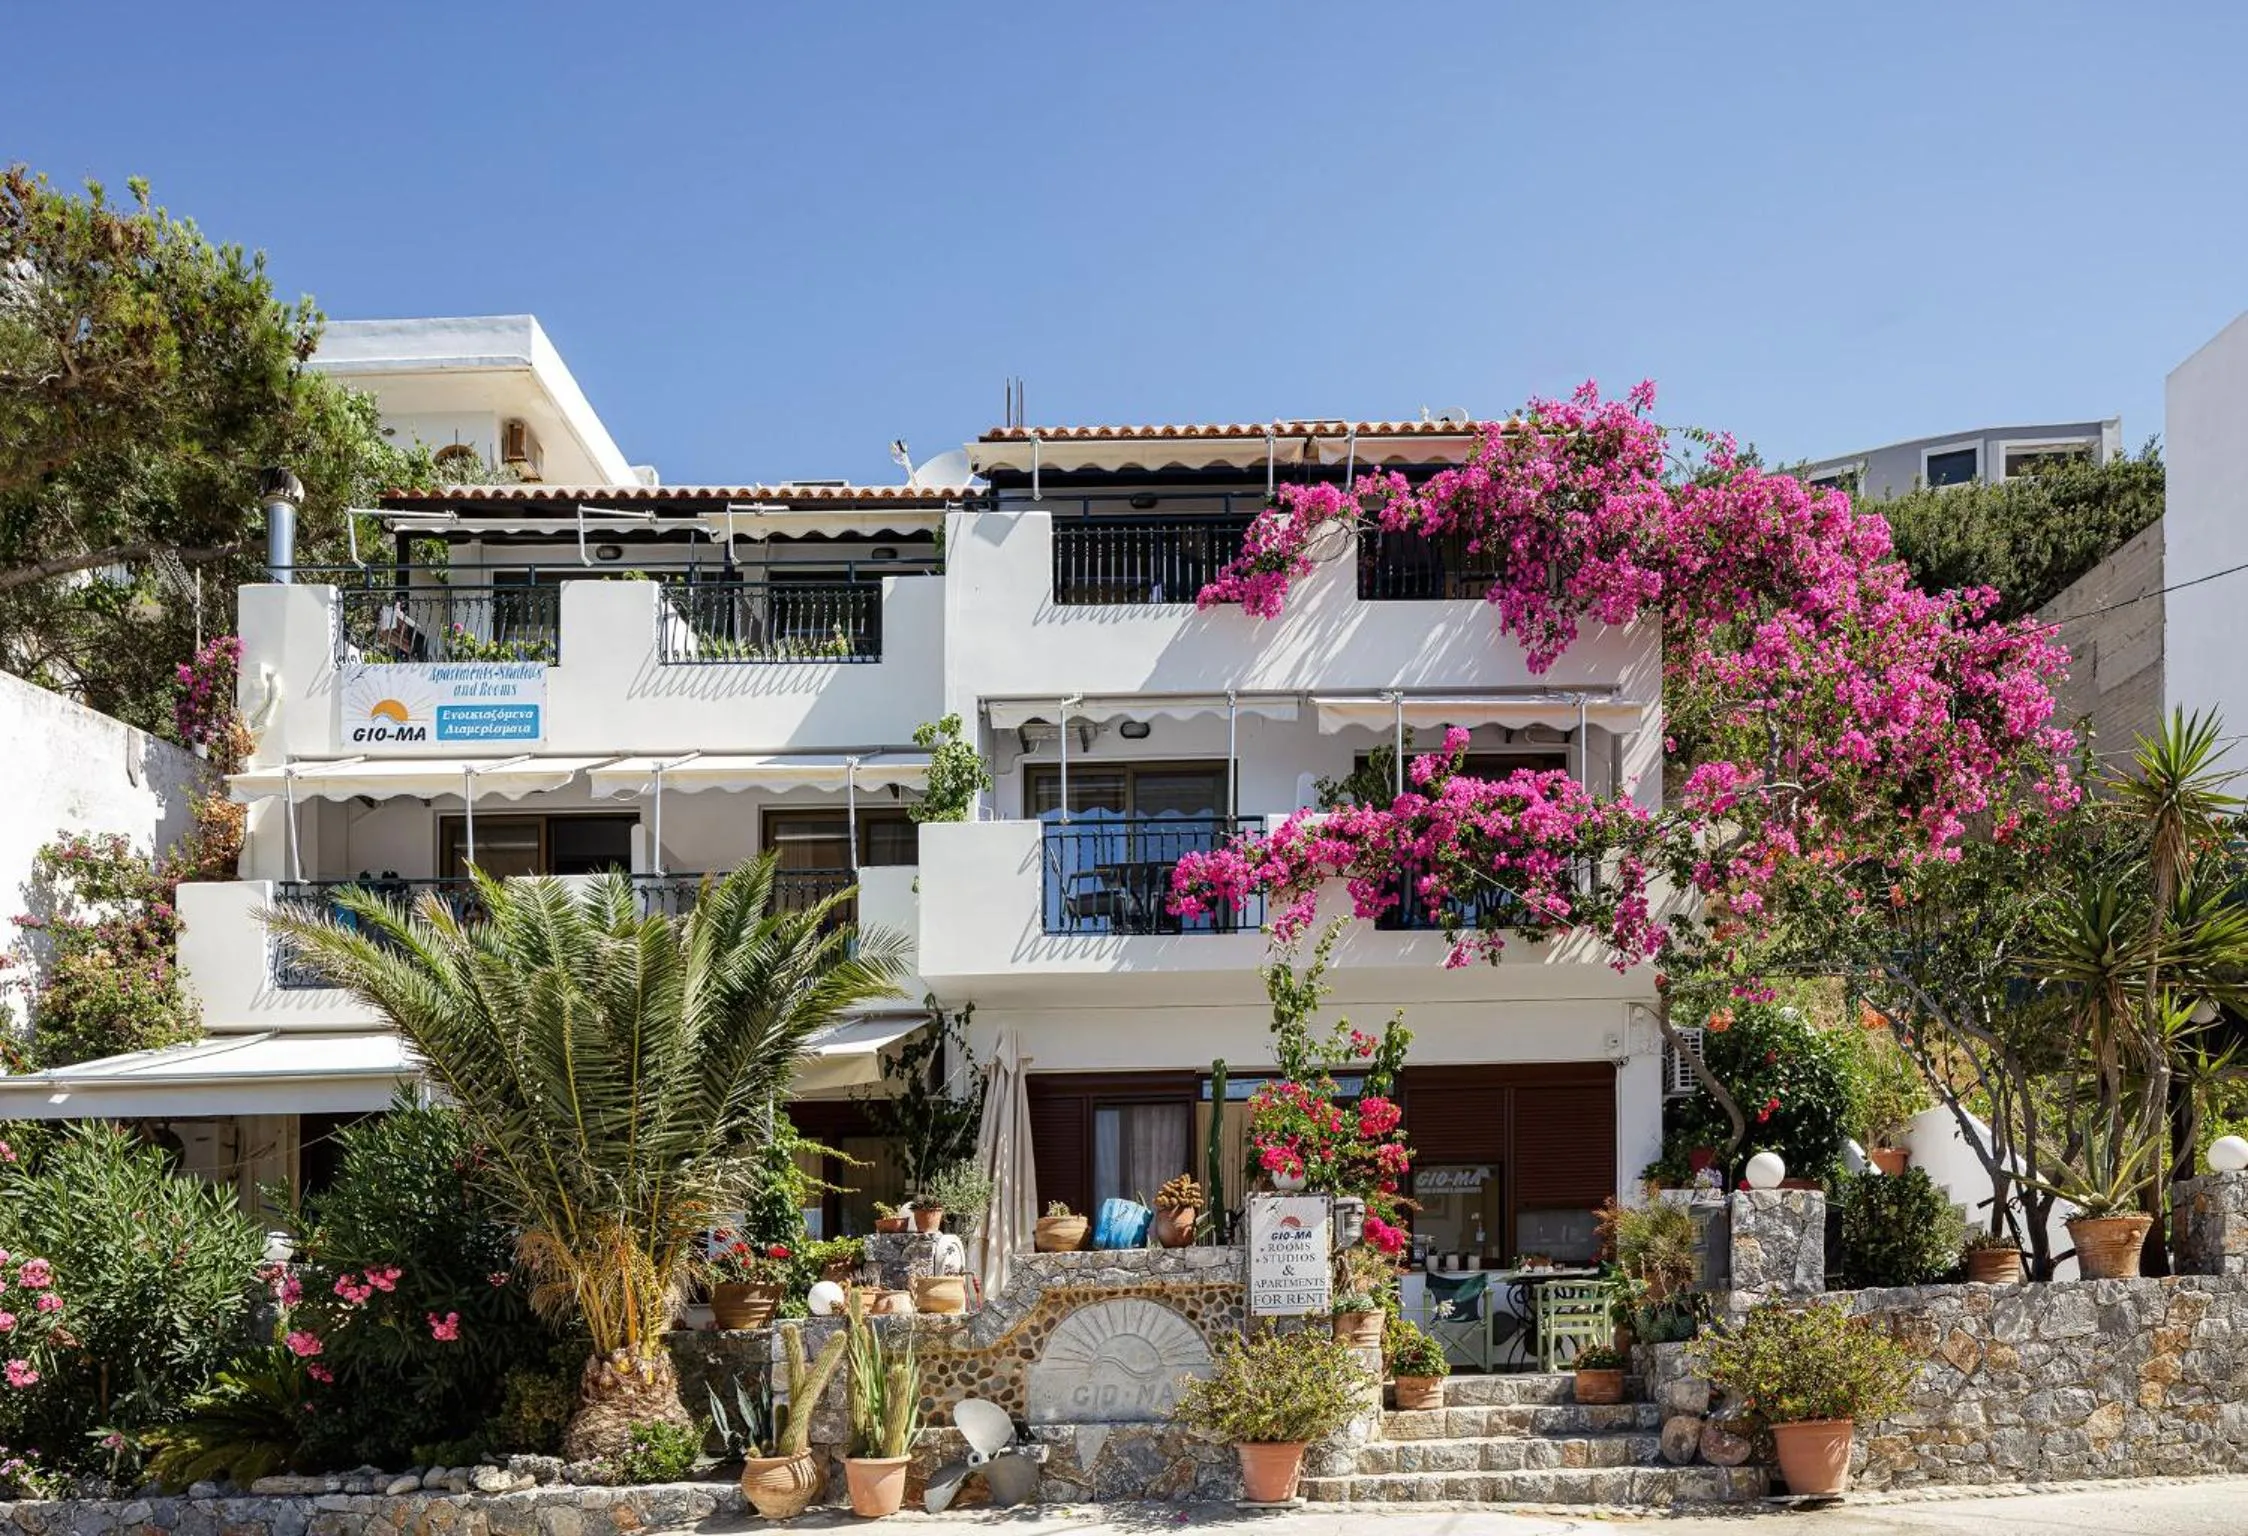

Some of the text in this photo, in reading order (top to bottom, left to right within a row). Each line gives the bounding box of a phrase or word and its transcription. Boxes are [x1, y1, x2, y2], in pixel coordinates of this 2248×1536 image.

[454, 681, 518, 696] and Rooms
[442, 709, 534, 722] Ενοικιαζόμενα
[352, 726, 427, 743] GIO-MA
[444, 723, 532, 737] Διαμερίσματα
[1415, 1171, 1481, 1186] GIO-MA
[1271, 1231, 1312, 1240] GIO-MA
[1268, 1242, 1311, 1252] ROOMS
[1262, 1253, 1316, 1264] STUDIOS
[1282, 1264, 1295, 1277] &
[1254, 1278, 1325, 1288] APARTMENTS
[1254, 1292, 1325, 1306] FOR RENT
